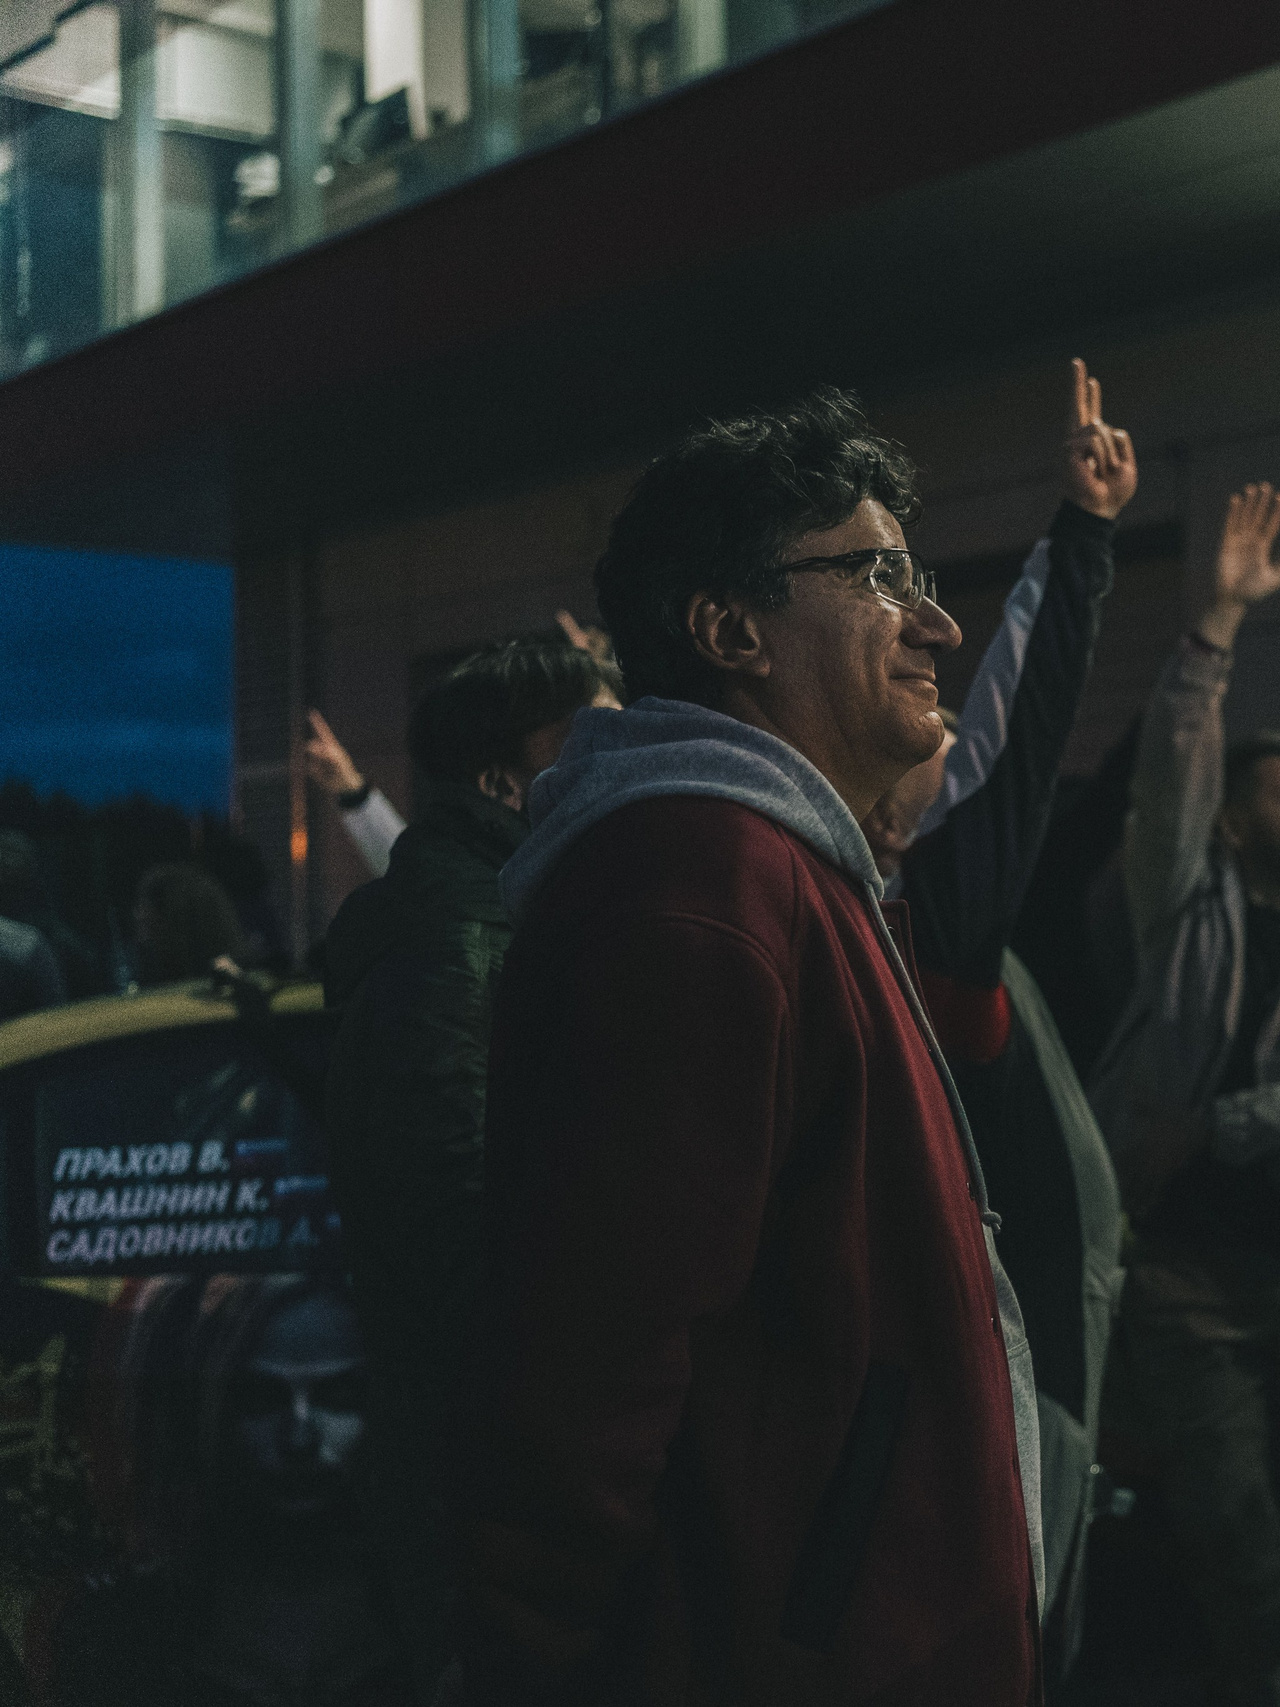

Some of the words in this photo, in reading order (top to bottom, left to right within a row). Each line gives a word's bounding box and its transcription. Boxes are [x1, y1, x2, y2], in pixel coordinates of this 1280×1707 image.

[54, 1141, 192, 1182] ПРАХОВ
[197, 1139, 230, 1173] В.
[51, 1180, 231, 1224] КВАШНИН
[234, 1177, 269, 1212] К.
[47, 1217, 280, 1264] САДОВНИКОВ
